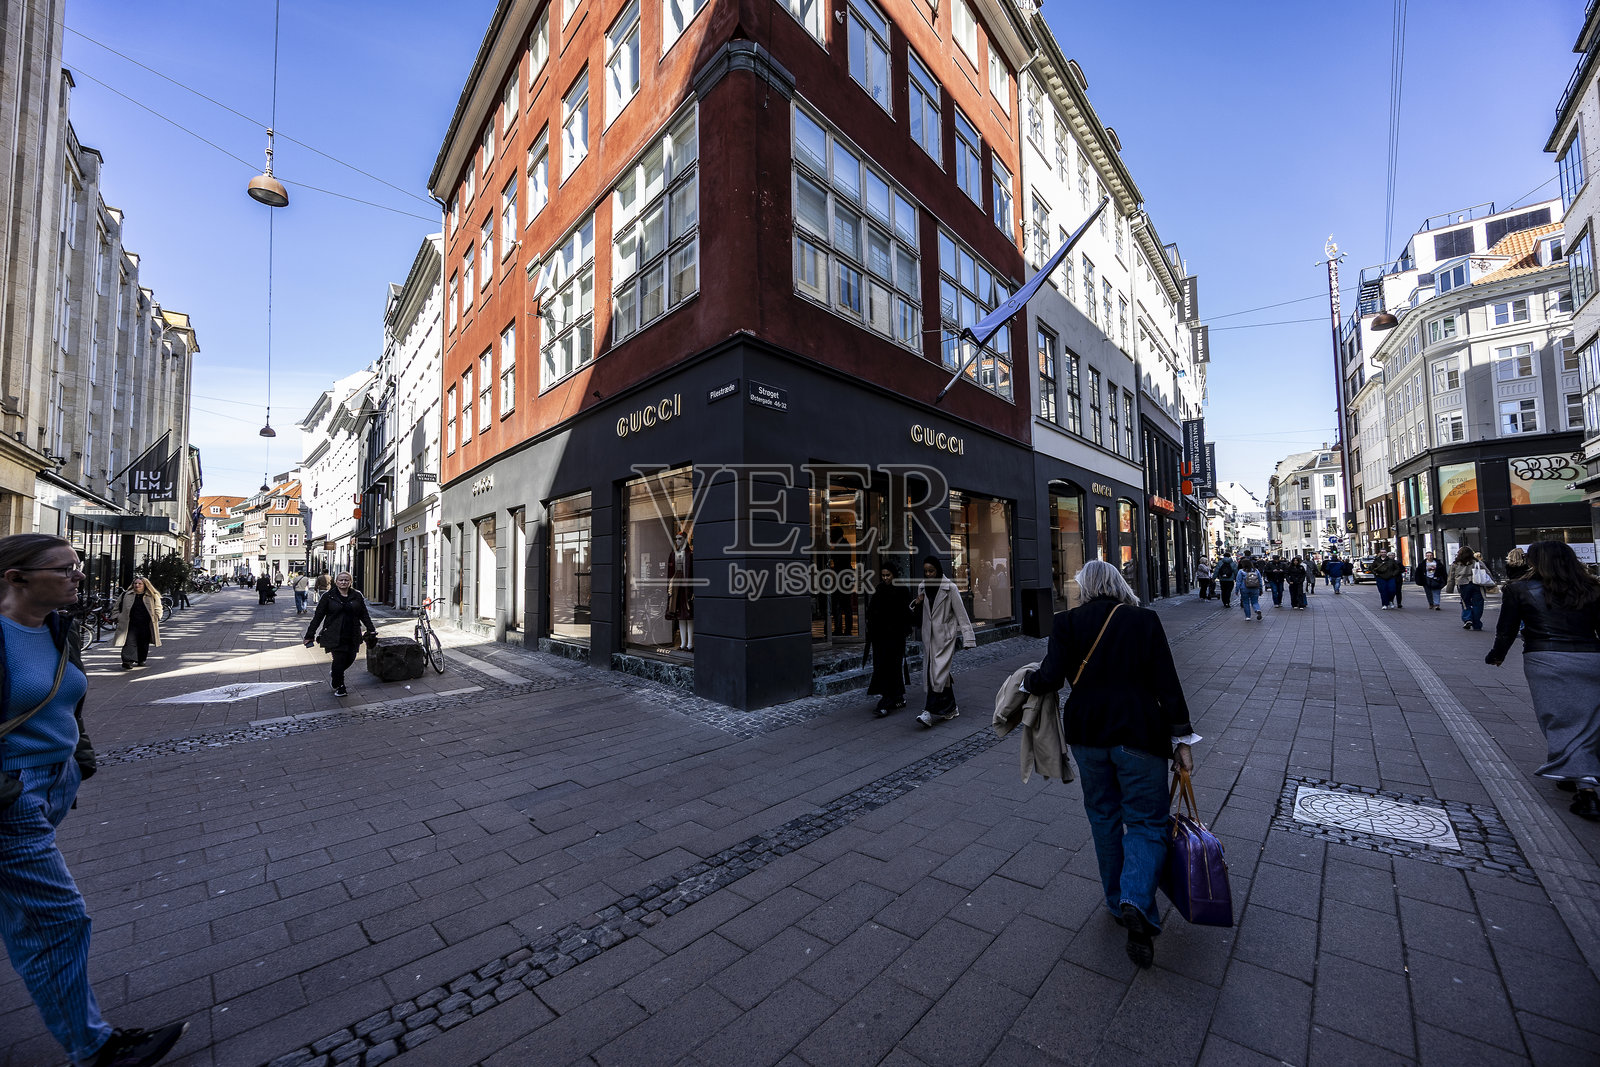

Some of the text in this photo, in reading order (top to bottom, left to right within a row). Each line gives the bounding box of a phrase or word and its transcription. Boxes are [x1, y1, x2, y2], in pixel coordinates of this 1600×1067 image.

[710, 384, 736, 400] Pilestræde
[750, 394, 772, 406] Østergade
[758, 386, 780, 400] Strøget
[616, 394, 681, 437] GUCCI
[910, 424, 964, 455] GUCCI
[472, 474, 494, 497] GUCCI
[1092, 482, 1112, 497] GUCCI
